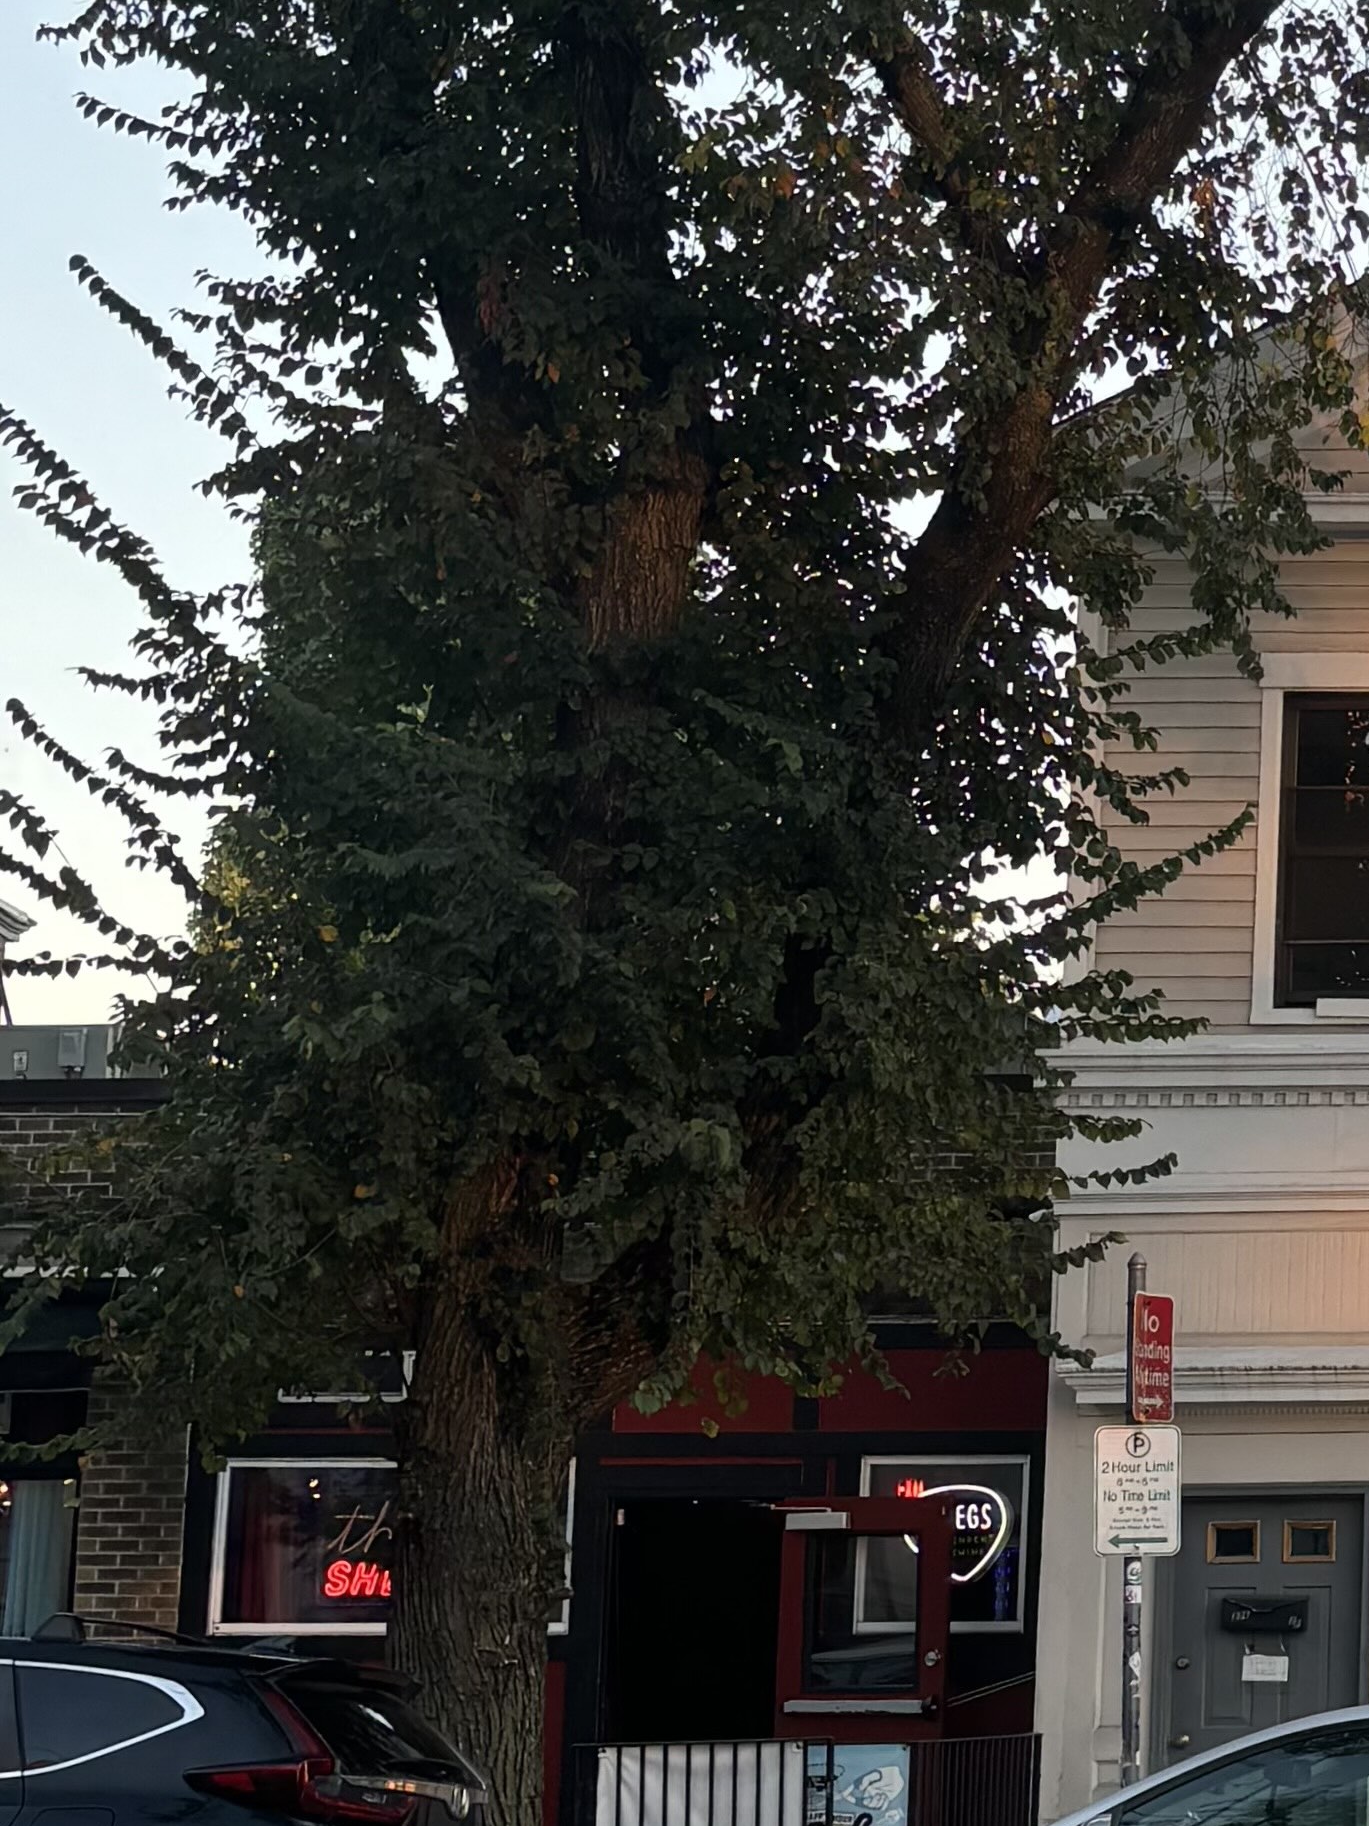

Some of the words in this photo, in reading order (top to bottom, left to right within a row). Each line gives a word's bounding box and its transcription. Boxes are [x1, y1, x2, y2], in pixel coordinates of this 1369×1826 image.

[1101, 1461, 1110, 1474] 2
[1111, 1461, 1142, 1474] Hour
[1145, 1460, 1175, 1473] Limit
[1103, 1489, 1118, 1502] No
